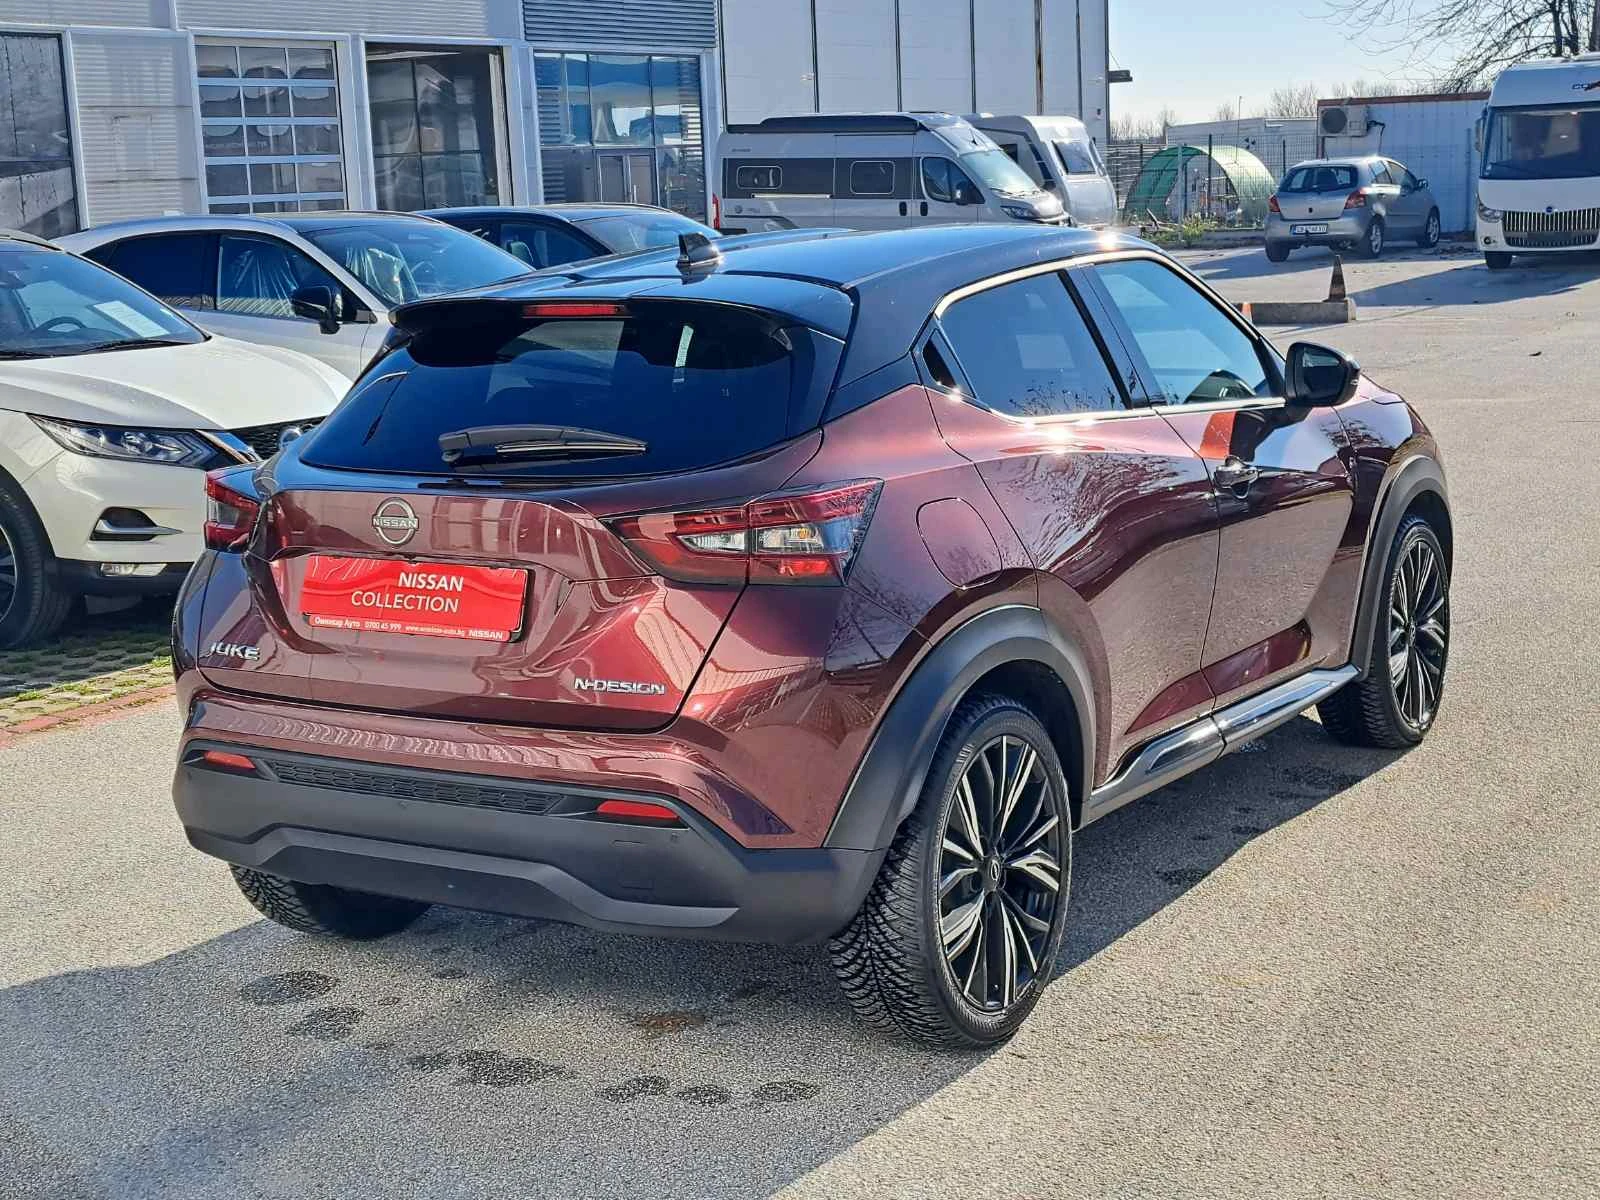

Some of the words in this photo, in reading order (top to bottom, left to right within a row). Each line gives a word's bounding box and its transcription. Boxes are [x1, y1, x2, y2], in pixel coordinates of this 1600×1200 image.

[373, 518, 418, 529] NISSAN
[398, 572, 464, 592] NISSAN
[351, 591, 459, 613] COLLECTION
[468, 629, 503, 640] NISSAN
[209, 642, 260, 660] JUKE
[575, 678, 665, 695] N-DESIGN
